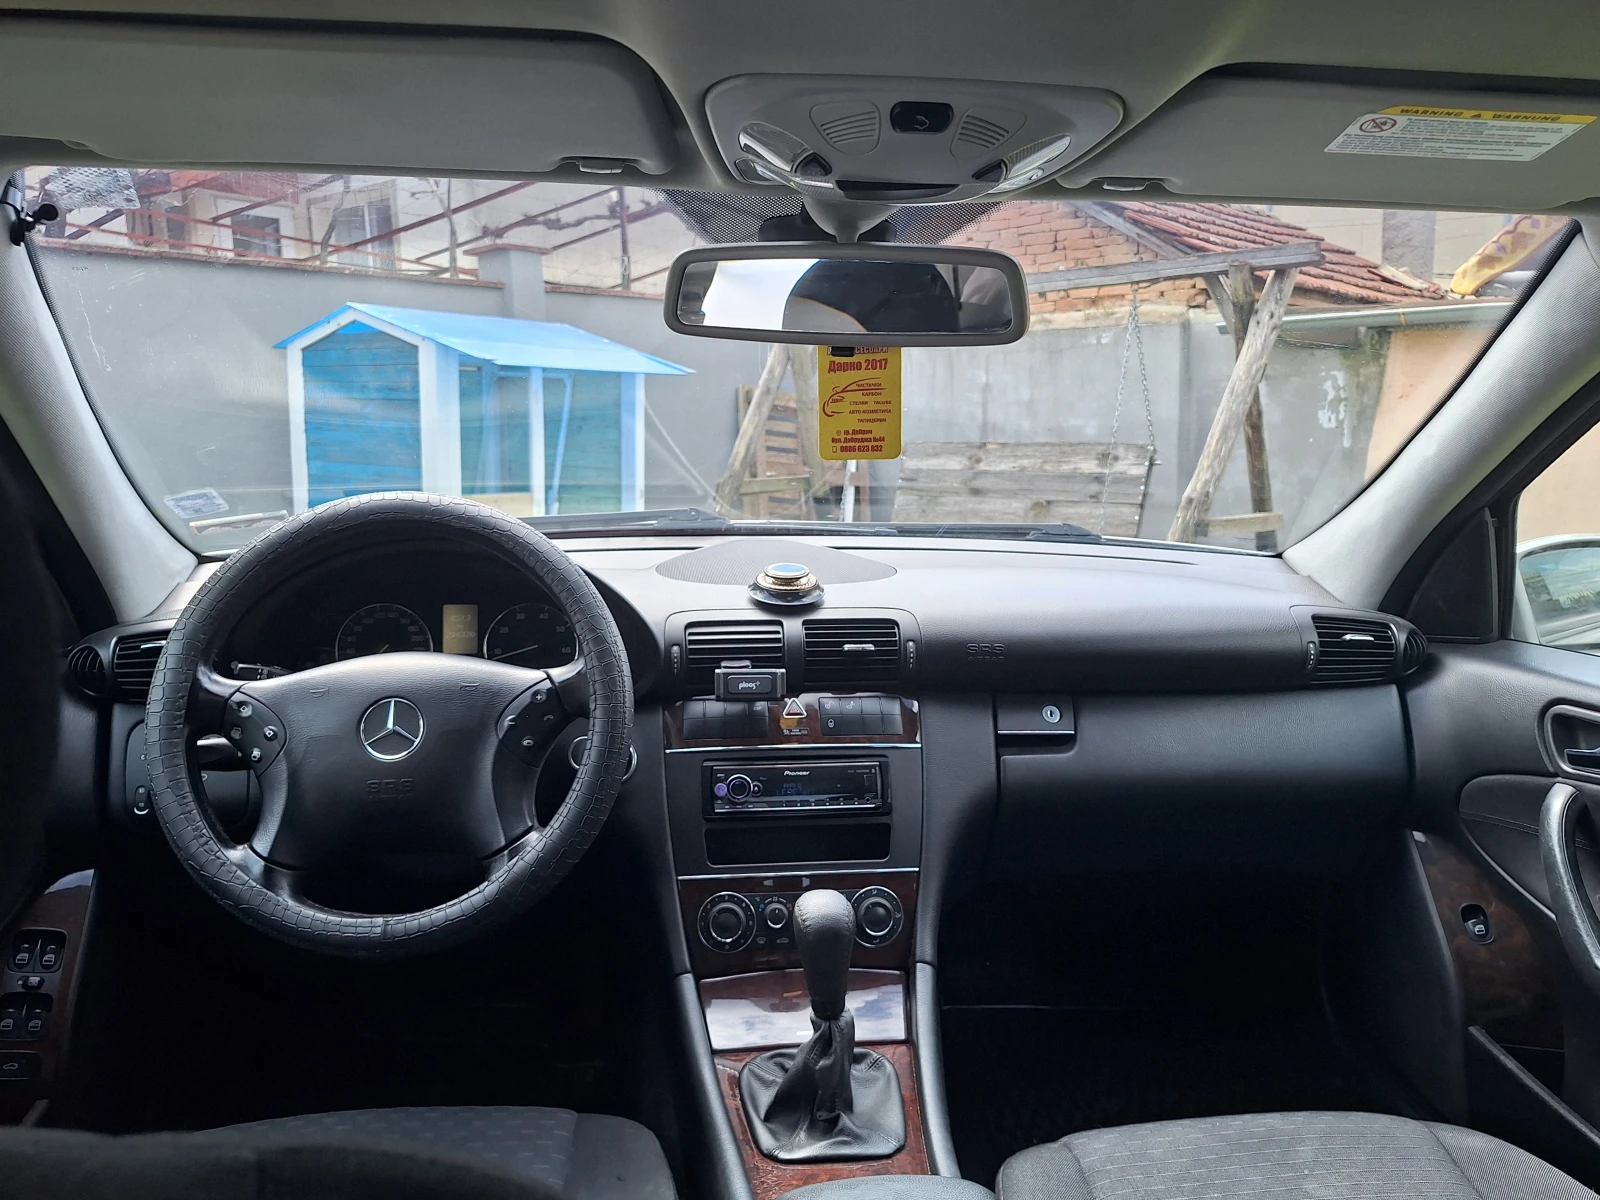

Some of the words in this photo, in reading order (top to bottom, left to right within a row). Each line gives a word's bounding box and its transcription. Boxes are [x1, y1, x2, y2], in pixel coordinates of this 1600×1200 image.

[1399, 108, 1464, 117] WARNING
[828, 360, 862, 374] Дарко
[864, 358, 888, 370] 2017
[857, 445, 869, 453] 623
[539, 612, 549, 620] 40
[966, 643, 1005, 653] SRS
